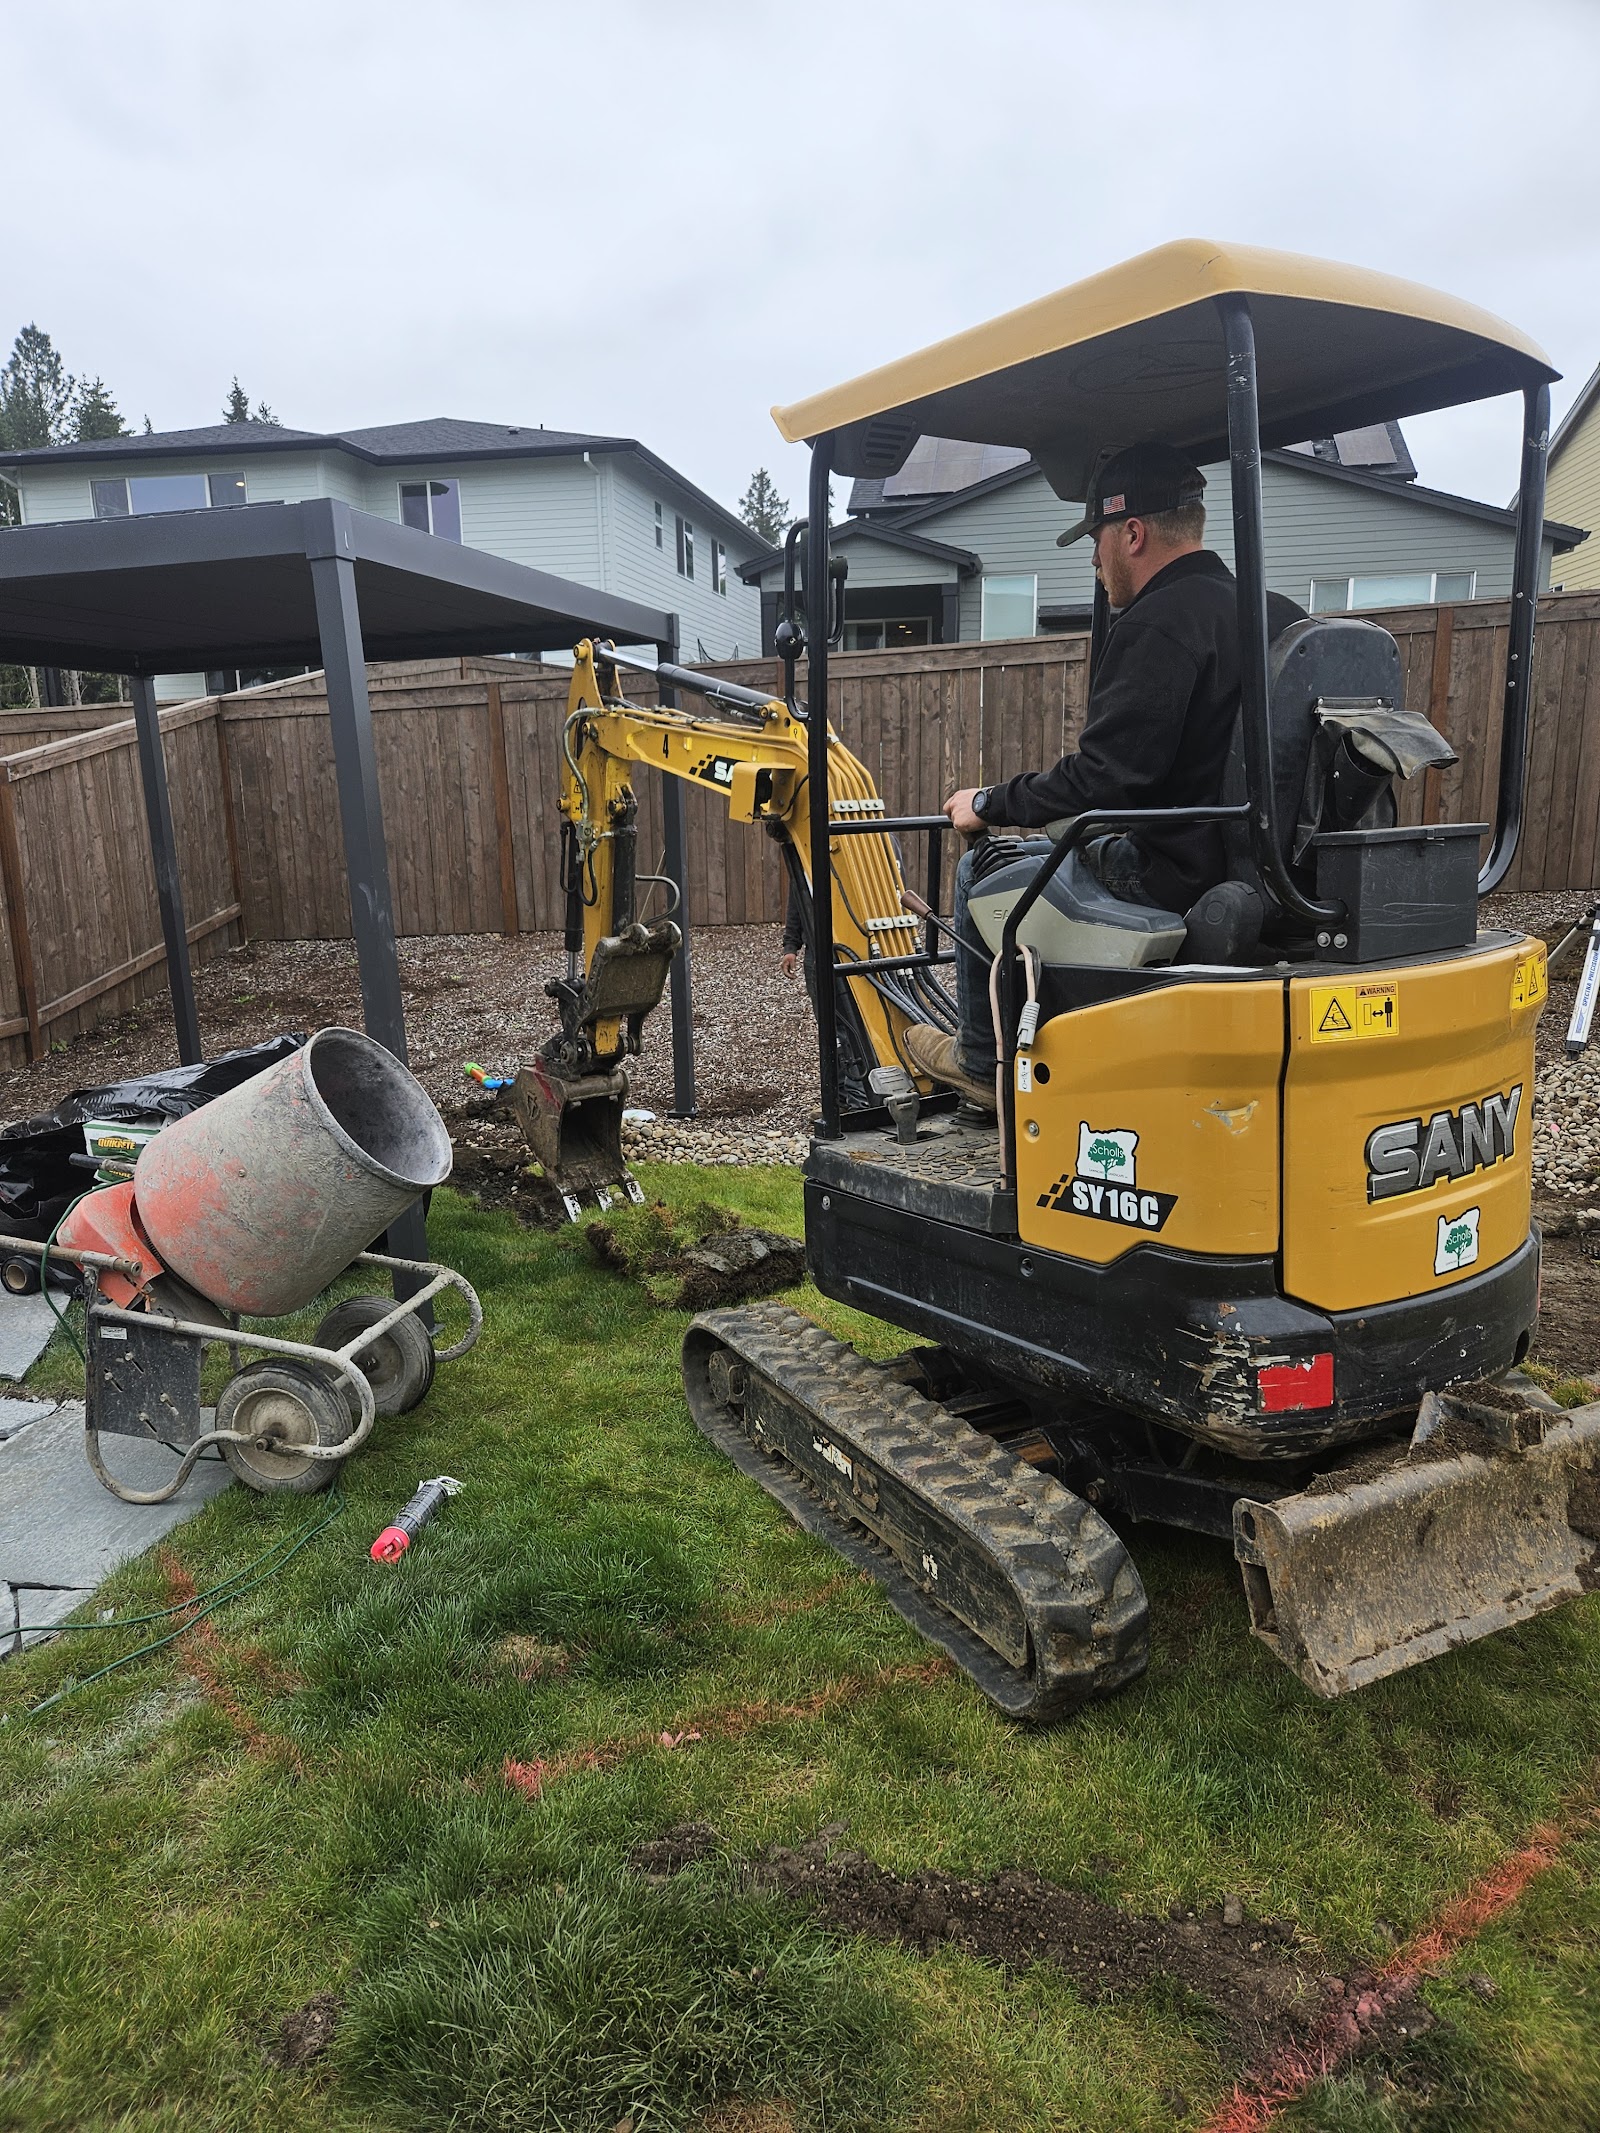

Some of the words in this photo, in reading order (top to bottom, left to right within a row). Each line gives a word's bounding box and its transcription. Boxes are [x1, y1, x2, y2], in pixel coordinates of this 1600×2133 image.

[663, 734, 669, 758] 4
[1366, 985, 1395, 995] WARNING
[1092, 1143, 1124, 1159] Scholls
[1366, 1084, 1522, 1203] SANY
[1072, 1180, 1159, 1226] SY16C
[1448, 1229, 1471, 1245] Scholls
